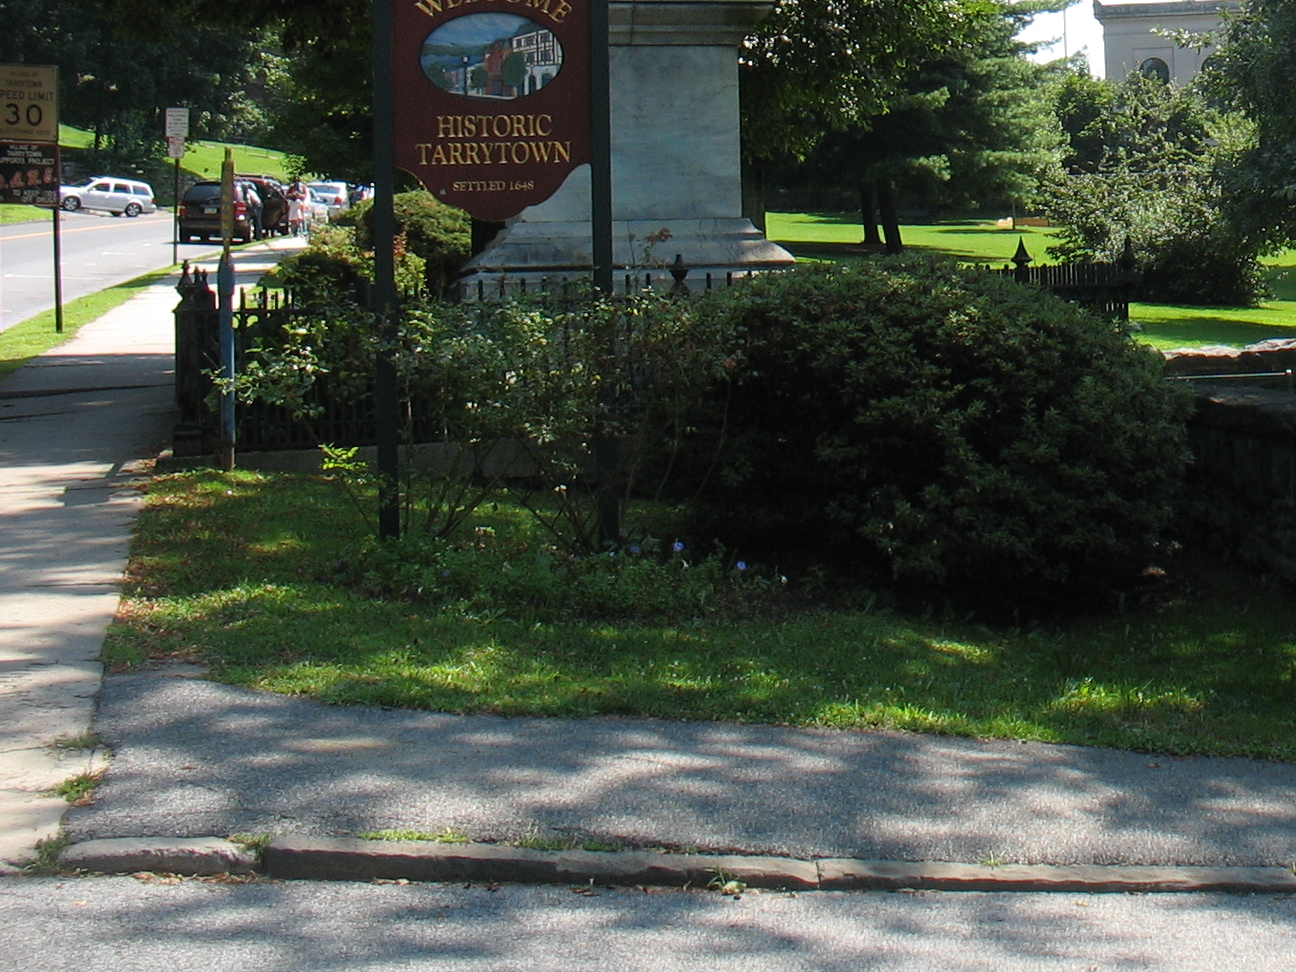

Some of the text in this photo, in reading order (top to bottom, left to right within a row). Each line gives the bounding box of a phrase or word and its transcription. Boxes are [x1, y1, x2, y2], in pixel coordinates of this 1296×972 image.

[0, 89, 55, 101] PEED LIMIT
[5, 103, 42, 127] 30
[436, 114, 553, 138] HISTORIC
[415, 141, 572, 166] TARRYTOWN
[452, 180, 535, 192] SETTLED 1648
